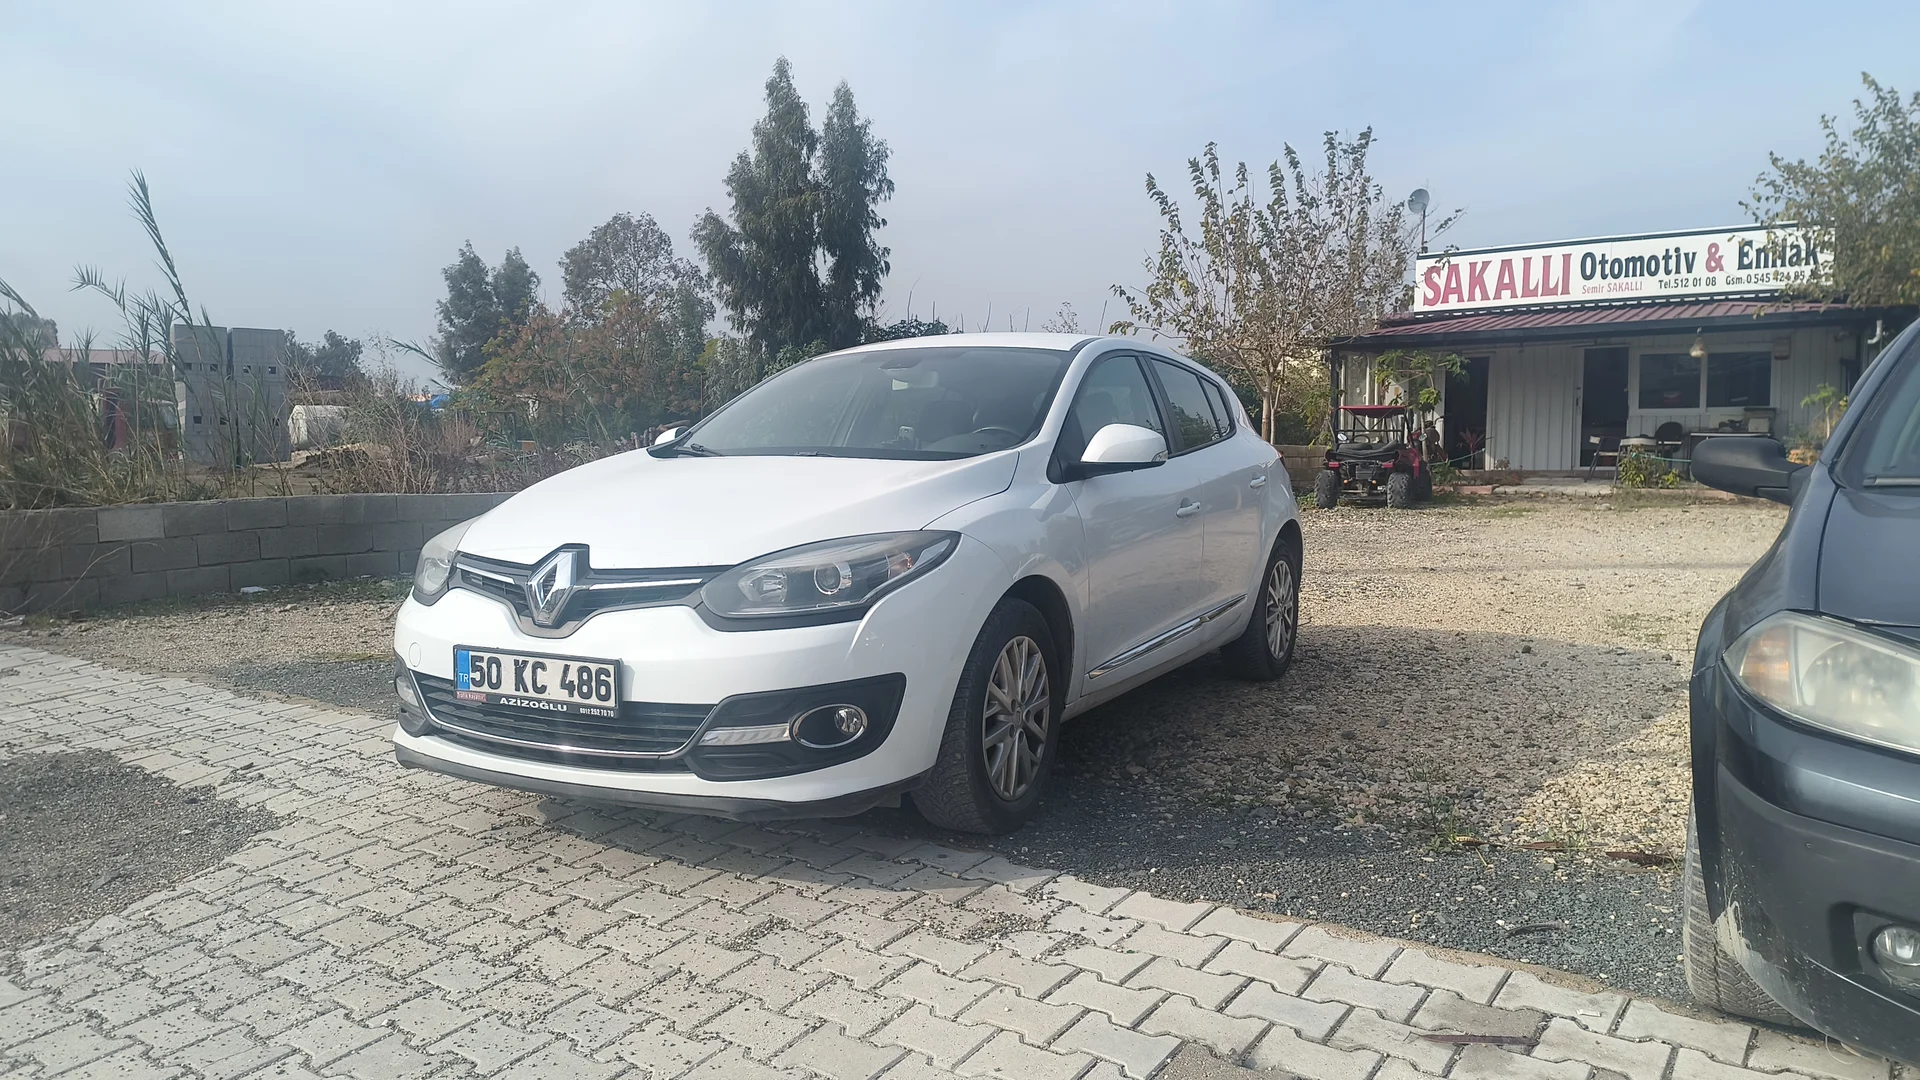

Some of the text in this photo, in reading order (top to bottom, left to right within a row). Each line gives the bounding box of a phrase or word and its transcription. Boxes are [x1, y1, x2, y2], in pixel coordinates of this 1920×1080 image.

[1423, 253, 1572, 307] SAKALLI
[1580, 246, 1698, 281] Otomotiv
[1705, 242, 1725, 273] &
[1754, 272, 1771, 284] 545
[1582, 281, 1643, 294] Semir SAKALLI
[1692, 276, 1702, 287] 01
[1705, 276, 1717, 286] 08
[459, 672, 469, 683] TR
[470, 655, 612, 702] 50 KC 486
[499, 697, 567, 712] AZİZOĞLU
